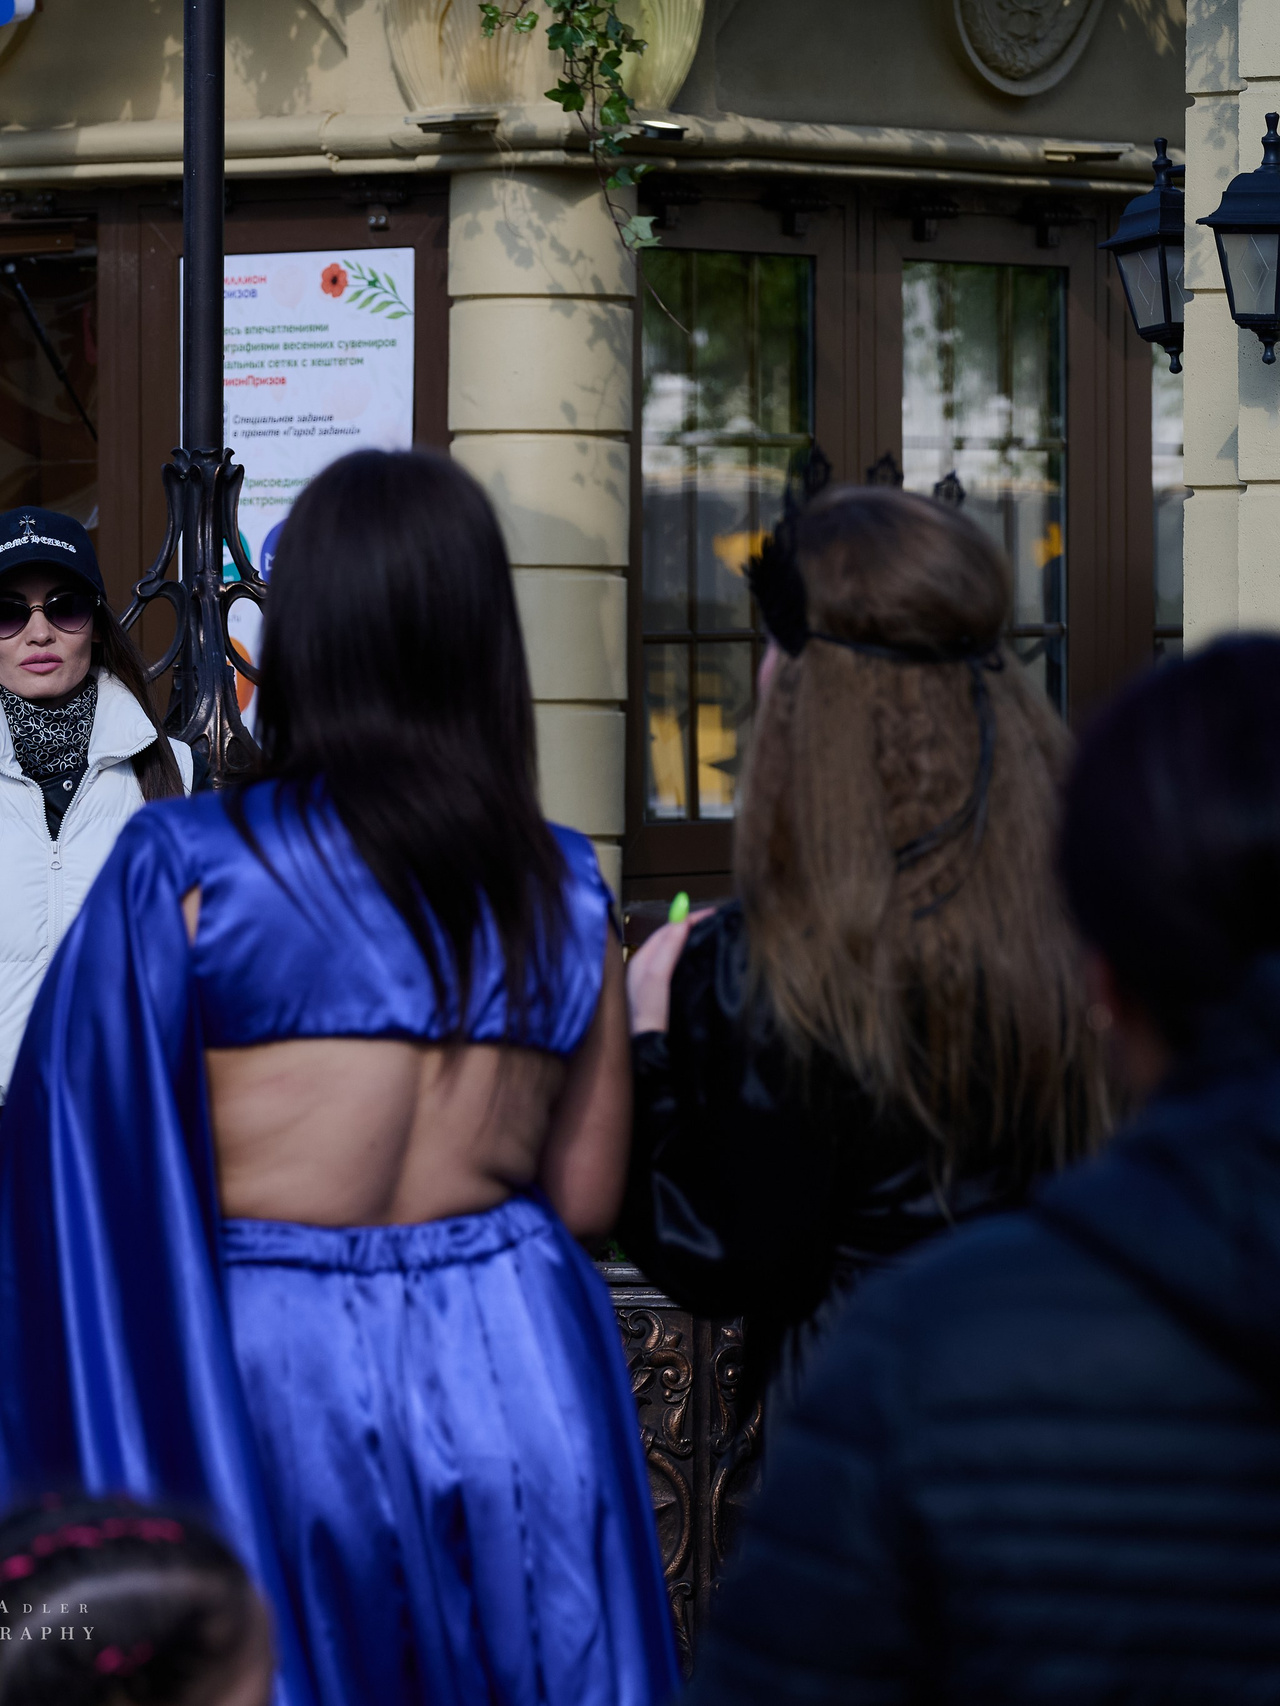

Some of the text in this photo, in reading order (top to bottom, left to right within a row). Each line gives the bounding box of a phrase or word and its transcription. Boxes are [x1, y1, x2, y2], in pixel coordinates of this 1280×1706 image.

[224, 324, 329, 335] есь впечатлениями
[224, 338, 397, 354] графиями весенних сувениров
[224, 356, 364, 369] альных сетях с хештегом
